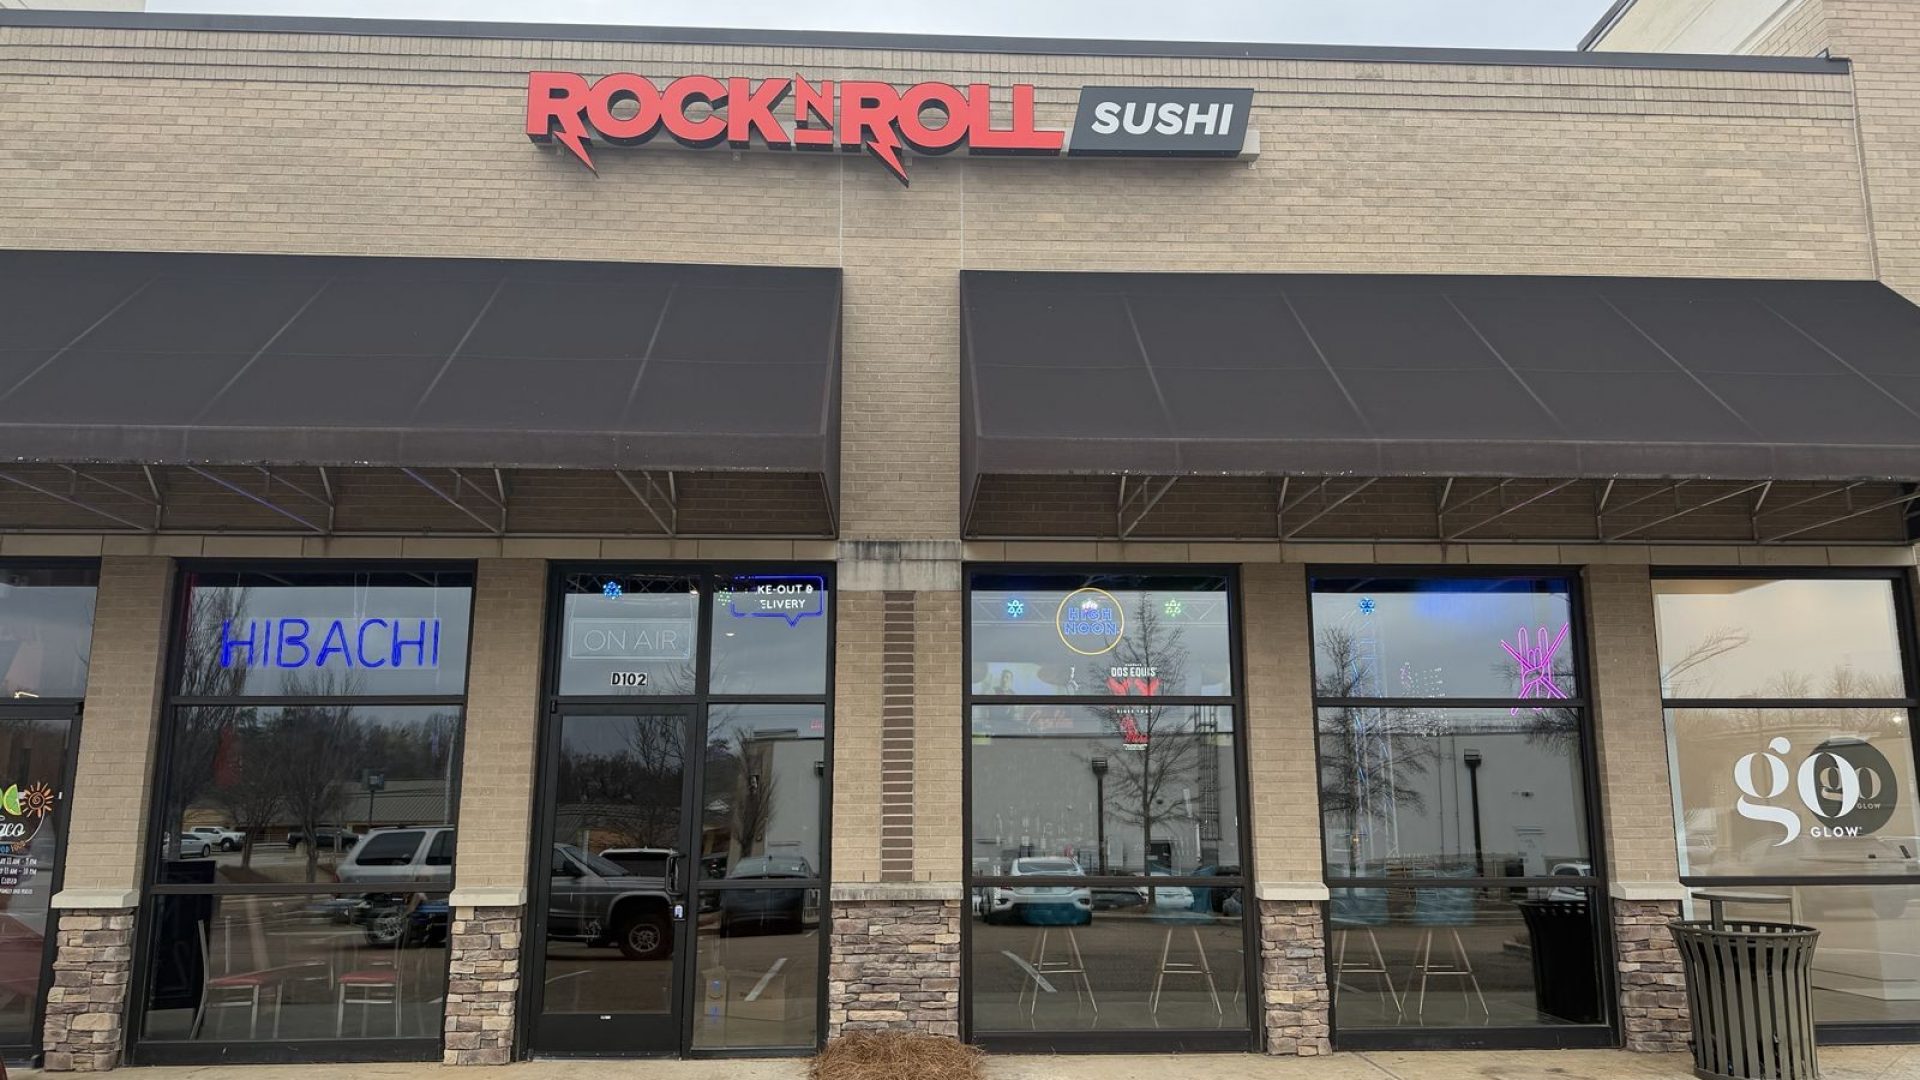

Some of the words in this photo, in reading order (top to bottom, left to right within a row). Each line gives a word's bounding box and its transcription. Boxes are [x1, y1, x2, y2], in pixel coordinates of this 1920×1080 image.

[1091, 101, 1234, 135] SUSHI
[756, 584, 803, 596] KE-OUT
[759, 599, 806, 610] ELIVERY
[1068, 607, 1112, 621] HIGH
[1063, 621, 1117, 636] NOON
[219, 618, 440, 668] HIBACHI
[584, 629, 626, 651] ON
[633, 630, 677, 650] AIR
[611, 672, 647, 686] D102
[1111, 666, 1129, 678] DOS
[1129, 666, 1156, 678] EQUIS
[1857, 802, 1881, 810] GLOW
[0, 817, 26, 839] aco
[1810, 826, 1858, 838] GLOW
